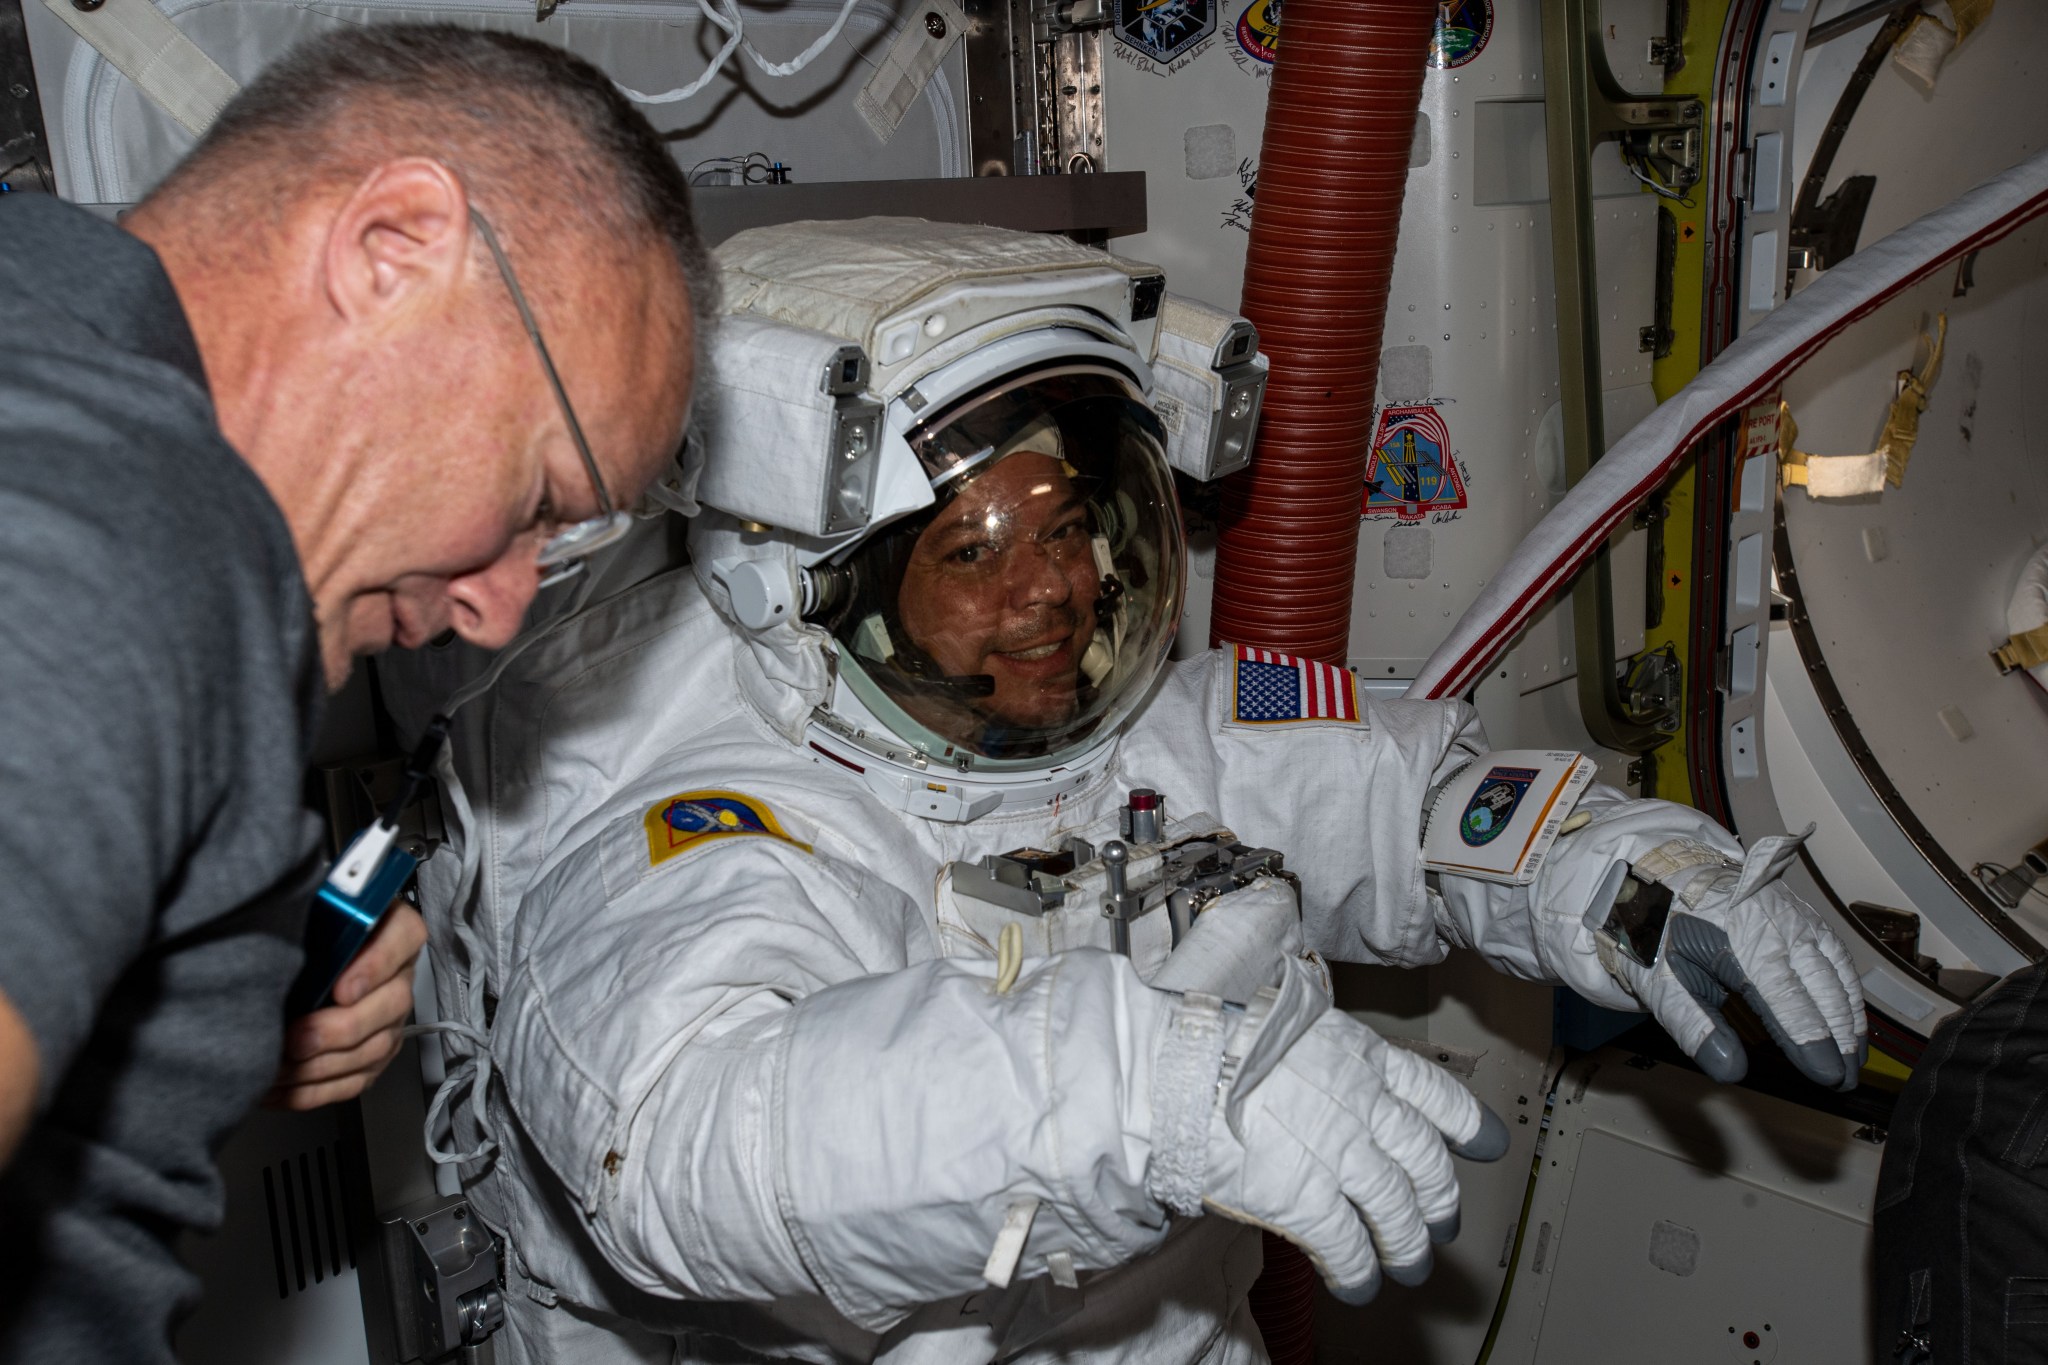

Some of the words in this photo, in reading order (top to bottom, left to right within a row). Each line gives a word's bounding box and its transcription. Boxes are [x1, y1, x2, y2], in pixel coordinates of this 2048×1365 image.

[1124, 34, 1158, 57] BEHNKEN
[1173, 32, 1204, 54] PATRICK
[1241, 26, 1260, 53] BEHNKEN
[1451, 50, 1479, 66] BRESNIK
[1477, 18, 1492, 49] SATCHER
[1388, 407, 1432, 415] ARCHAMBAULT
[1759, 414, 1775, 427] PORT
[1369, 455, 1378, 479] ARNOLD
[1421, 476, 1437, 486] 119
[1449, 467, 1464, 497] ANTONELLI
